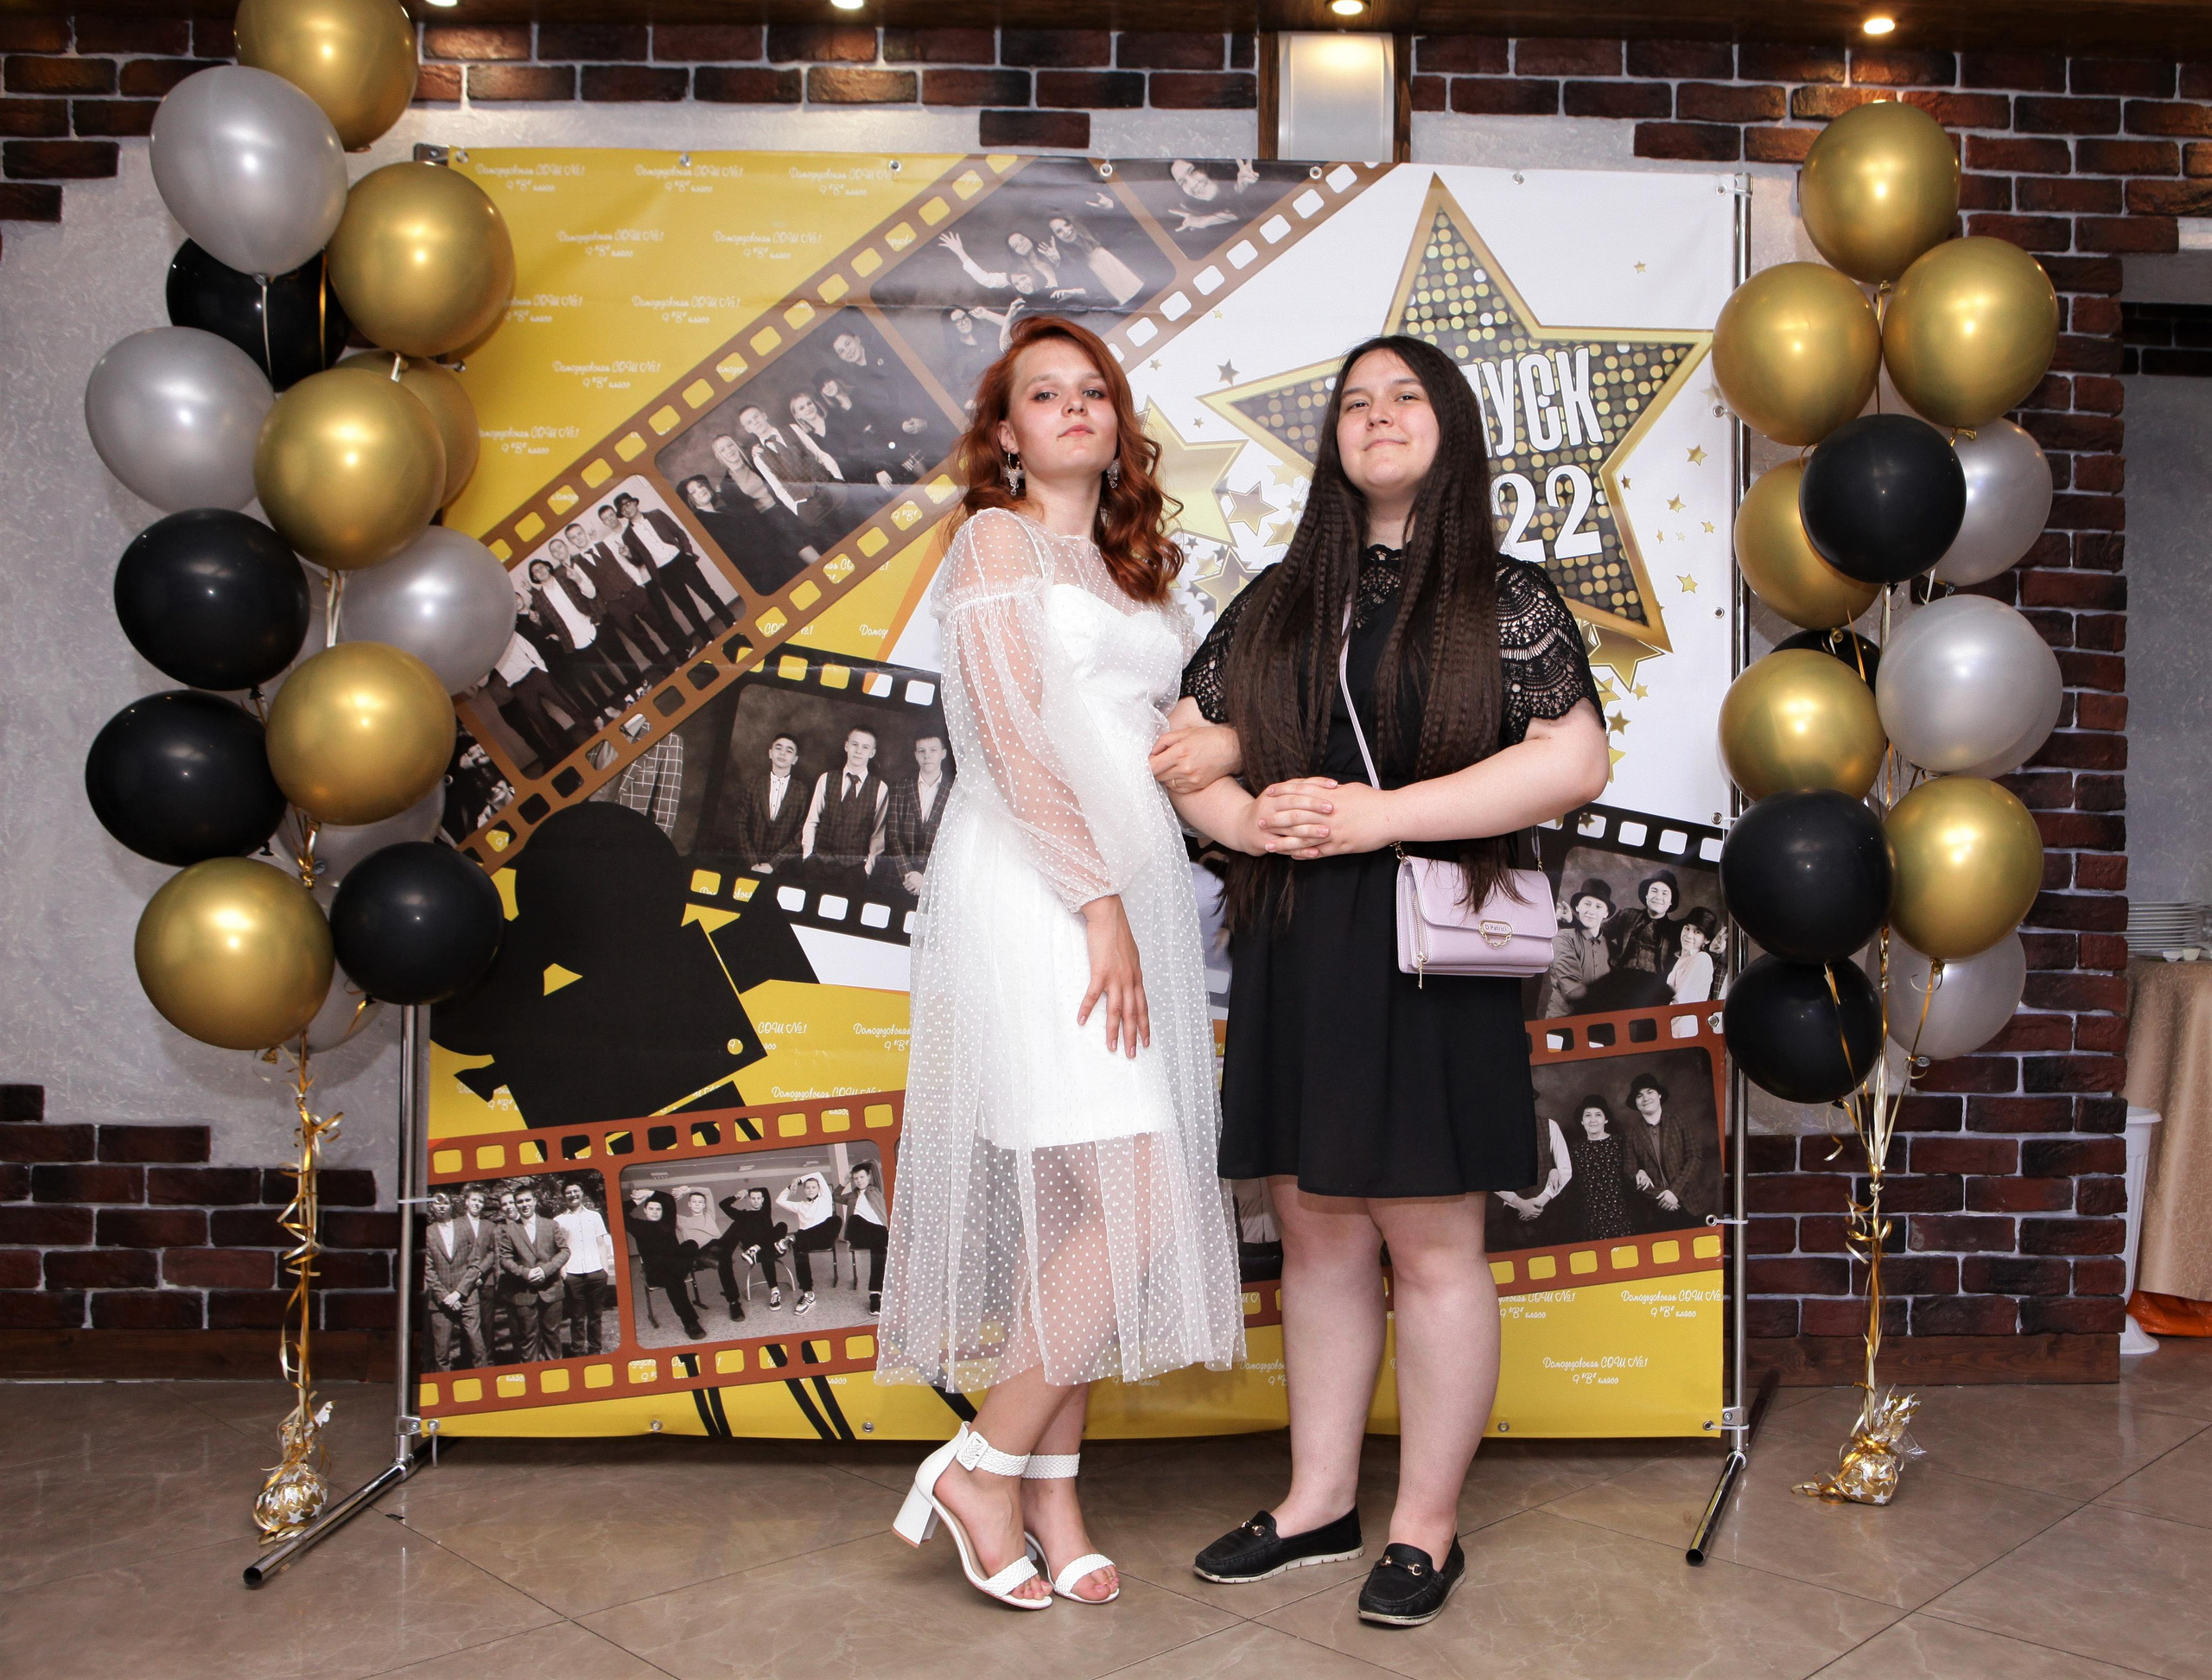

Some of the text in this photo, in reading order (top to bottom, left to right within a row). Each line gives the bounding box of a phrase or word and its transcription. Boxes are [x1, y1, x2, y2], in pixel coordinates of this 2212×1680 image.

[1459, 347, 1605, 459] УСК
[1490, 464, 1603, 563] 22
[758, 1022, 784, 1034] СОШ
[884, 1041, 891, 1051] 9
[1620, 1290, 1676, 1304] Домодедовская
[1678, 1290, 1703, 1301] СОШ
[1500, 1308, 1507, 1318] 9
[1650, 1308, 1657, 1317] 9
[1543, 1356, 1649, 1371] Домодедовская СОШ №1
[1573, 1374, 1580, 1384] 9
